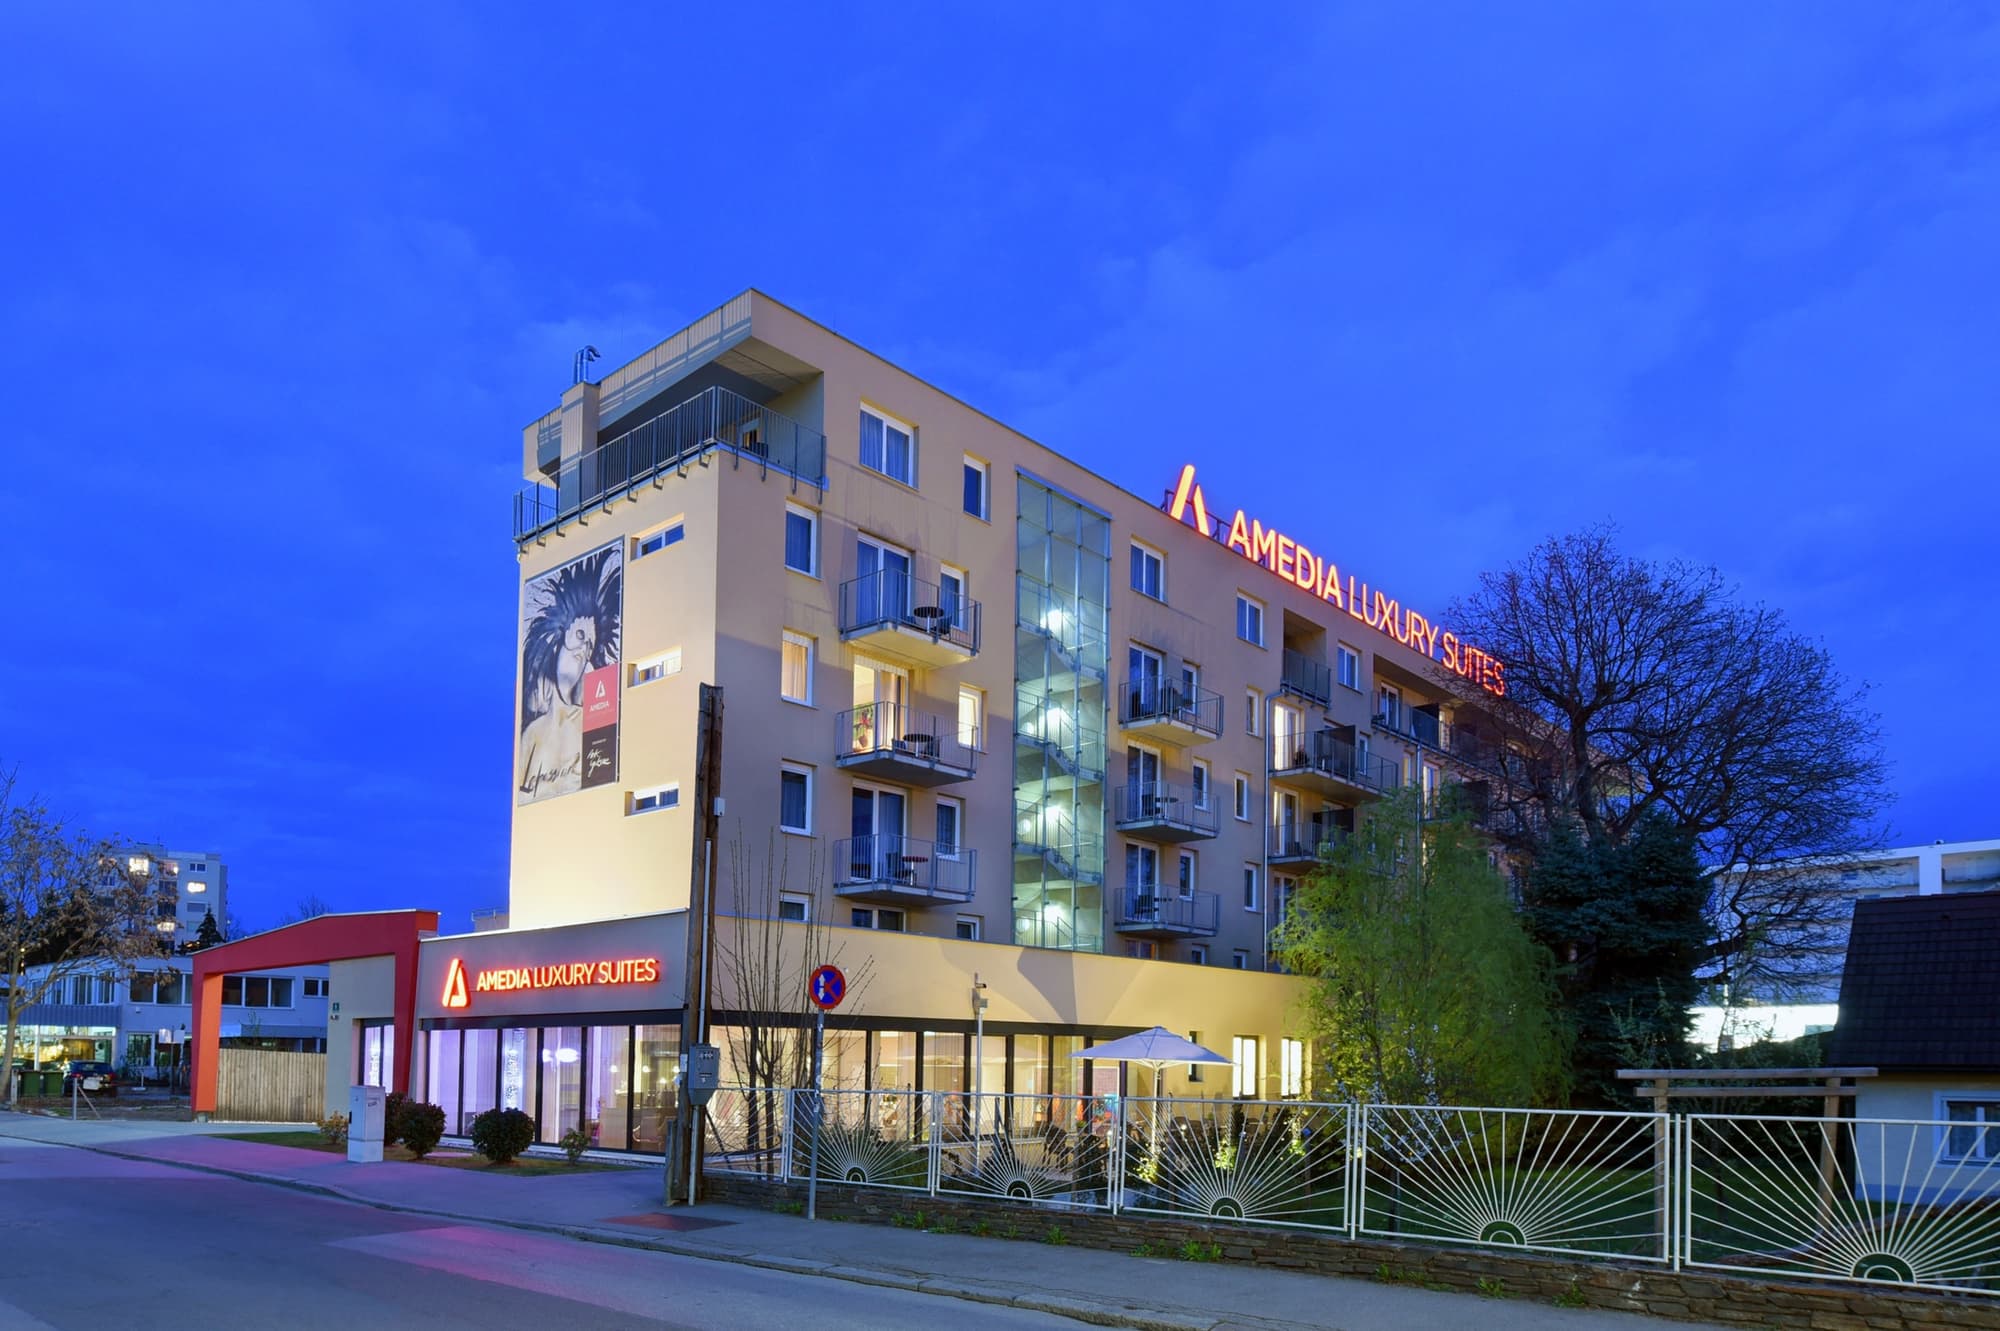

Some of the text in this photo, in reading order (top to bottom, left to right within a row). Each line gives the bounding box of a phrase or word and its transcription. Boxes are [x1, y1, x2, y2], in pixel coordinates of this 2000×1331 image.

[1227, 509, 1505, 697] AMEDIA LUXURY SUITES
[476, 957, 658, 992] AMEDIA LUXURY SUITES
